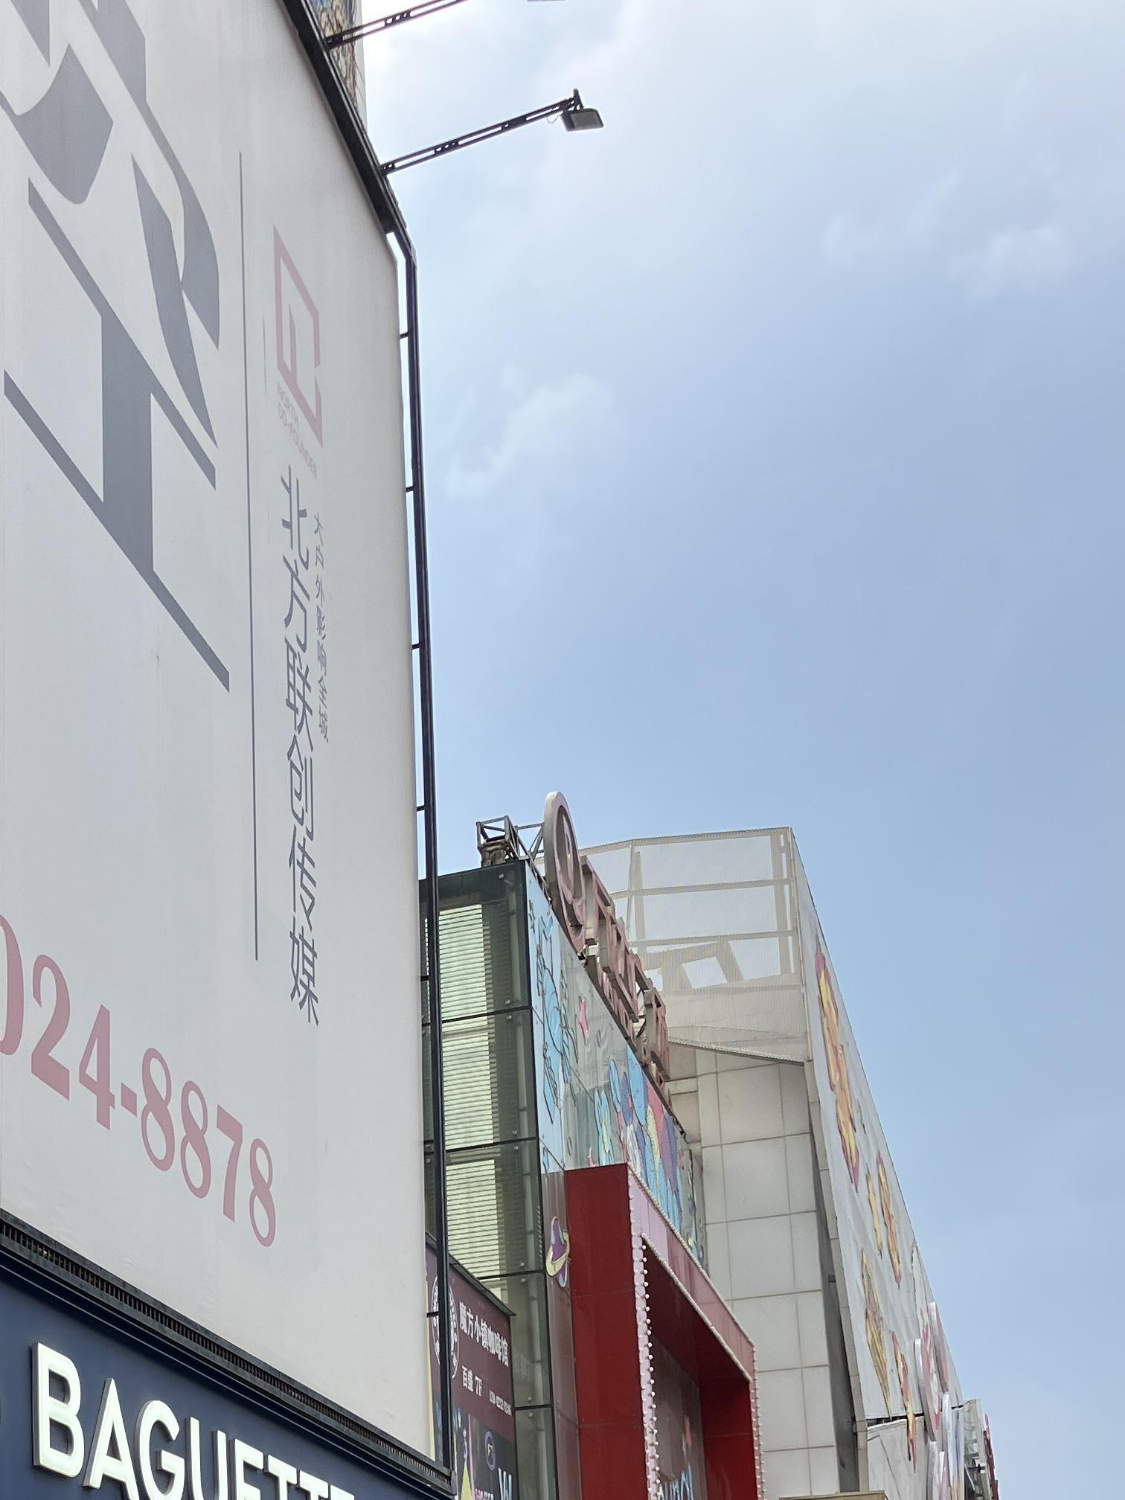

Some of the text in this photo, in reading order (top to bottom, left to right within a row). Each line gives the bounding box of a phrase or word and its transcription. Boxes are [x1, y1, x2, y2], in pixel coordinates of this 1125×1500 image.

[280, 463, 321, 1027] 北方联创传媒
[459, 1301, 510, 1368] 魔方小镇咖啡馆
